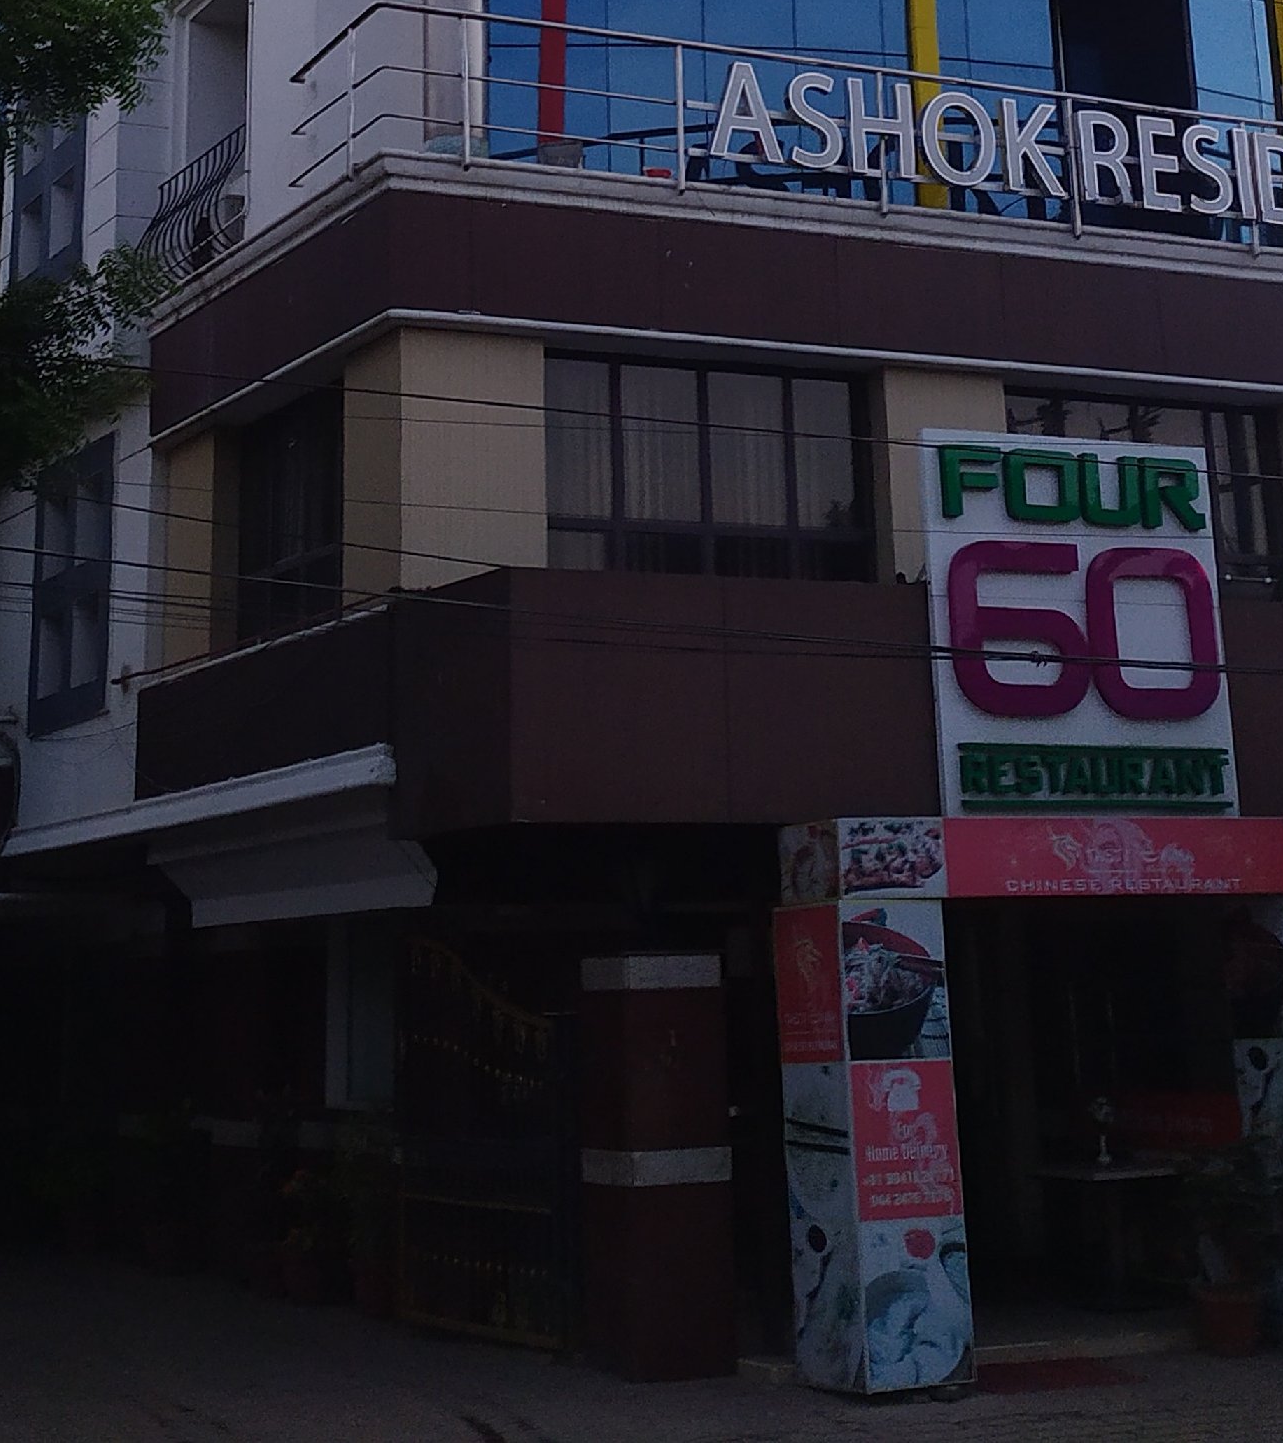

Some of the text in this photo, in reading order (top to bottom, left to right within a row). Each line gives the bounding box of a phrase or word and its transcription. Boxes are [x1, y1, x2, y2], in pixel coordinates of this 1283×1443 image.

[711, 62, 1068, 200] ASHOK
[938, 444, 1206, 531] FOUR
[947, 540, 1221, 722] 60
[958, 751, 1230, 796] RESTAURANT
